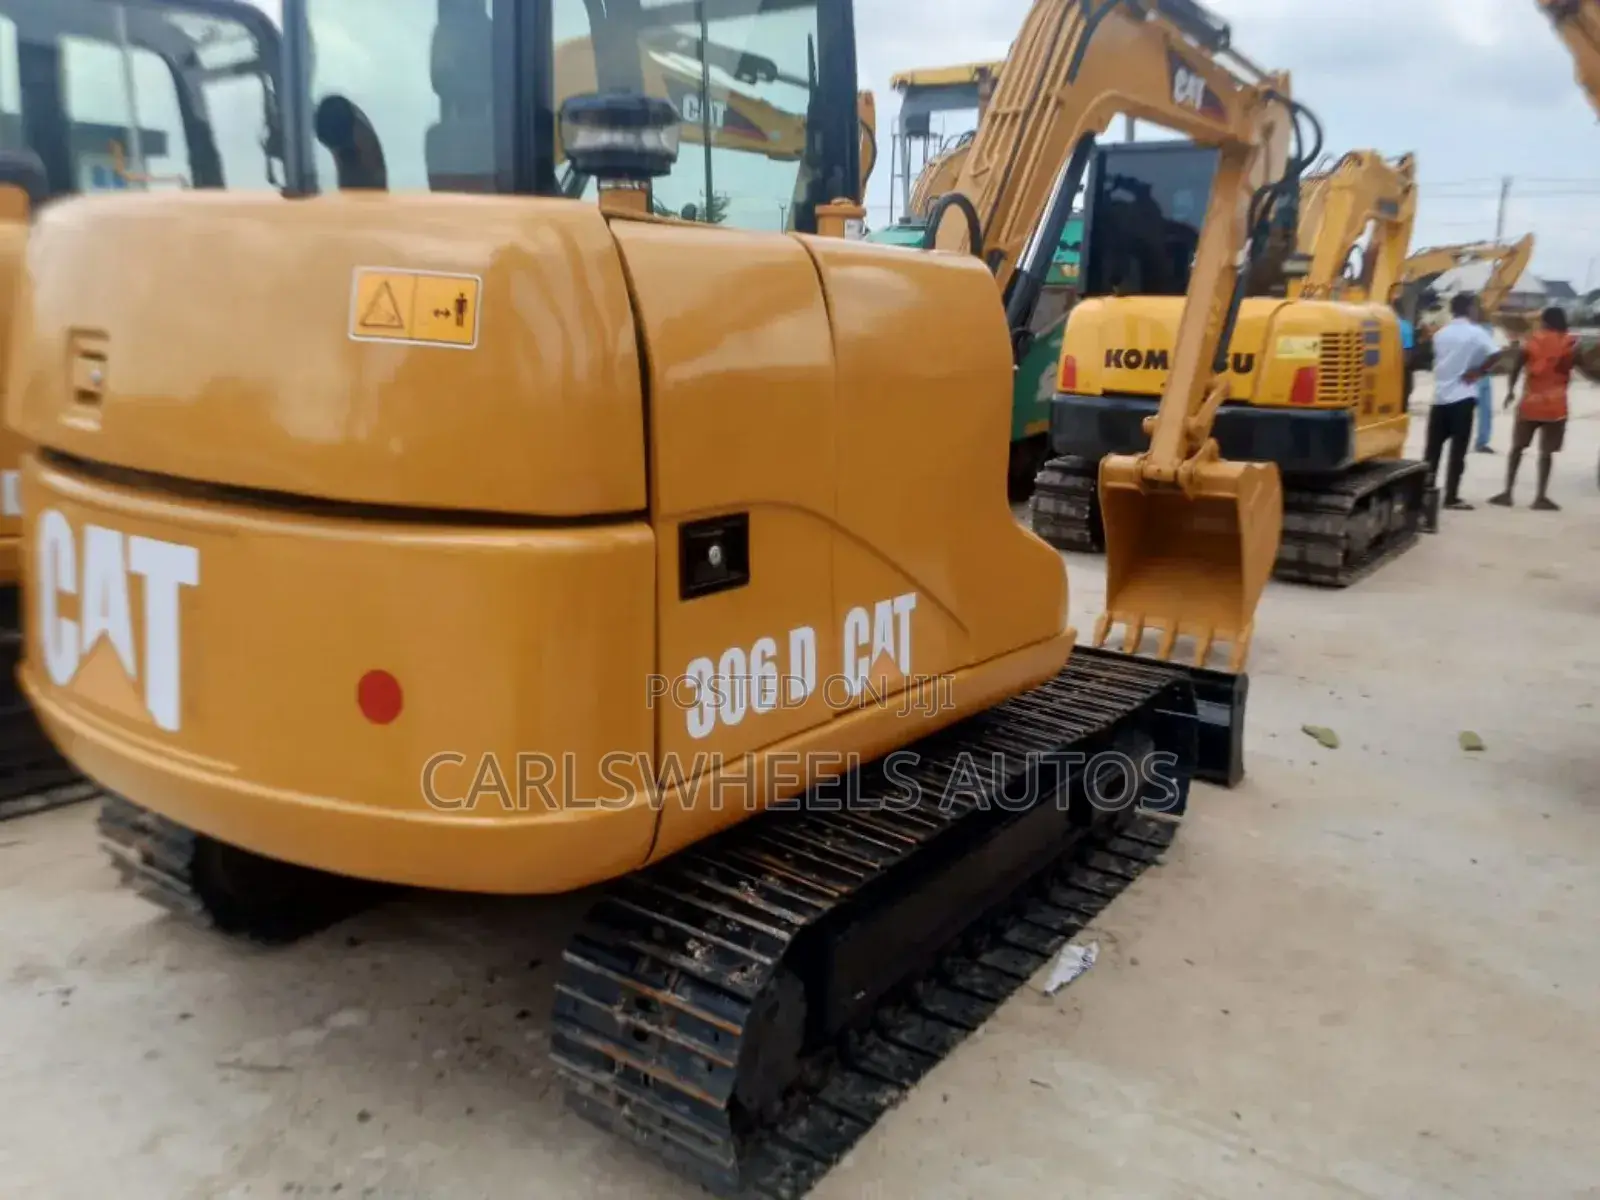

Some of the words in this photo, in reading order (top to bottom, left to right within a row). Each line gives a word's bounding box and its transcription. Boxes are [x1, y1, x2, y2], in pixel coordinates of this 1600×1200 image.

[1174, 68, 1206, 110] CAT
[38, 508, 199, 732] CAT
[685, 637, 777, 739] 306
[788, 625, 816, 702] D
[843, 591, 917, 697] CAT
